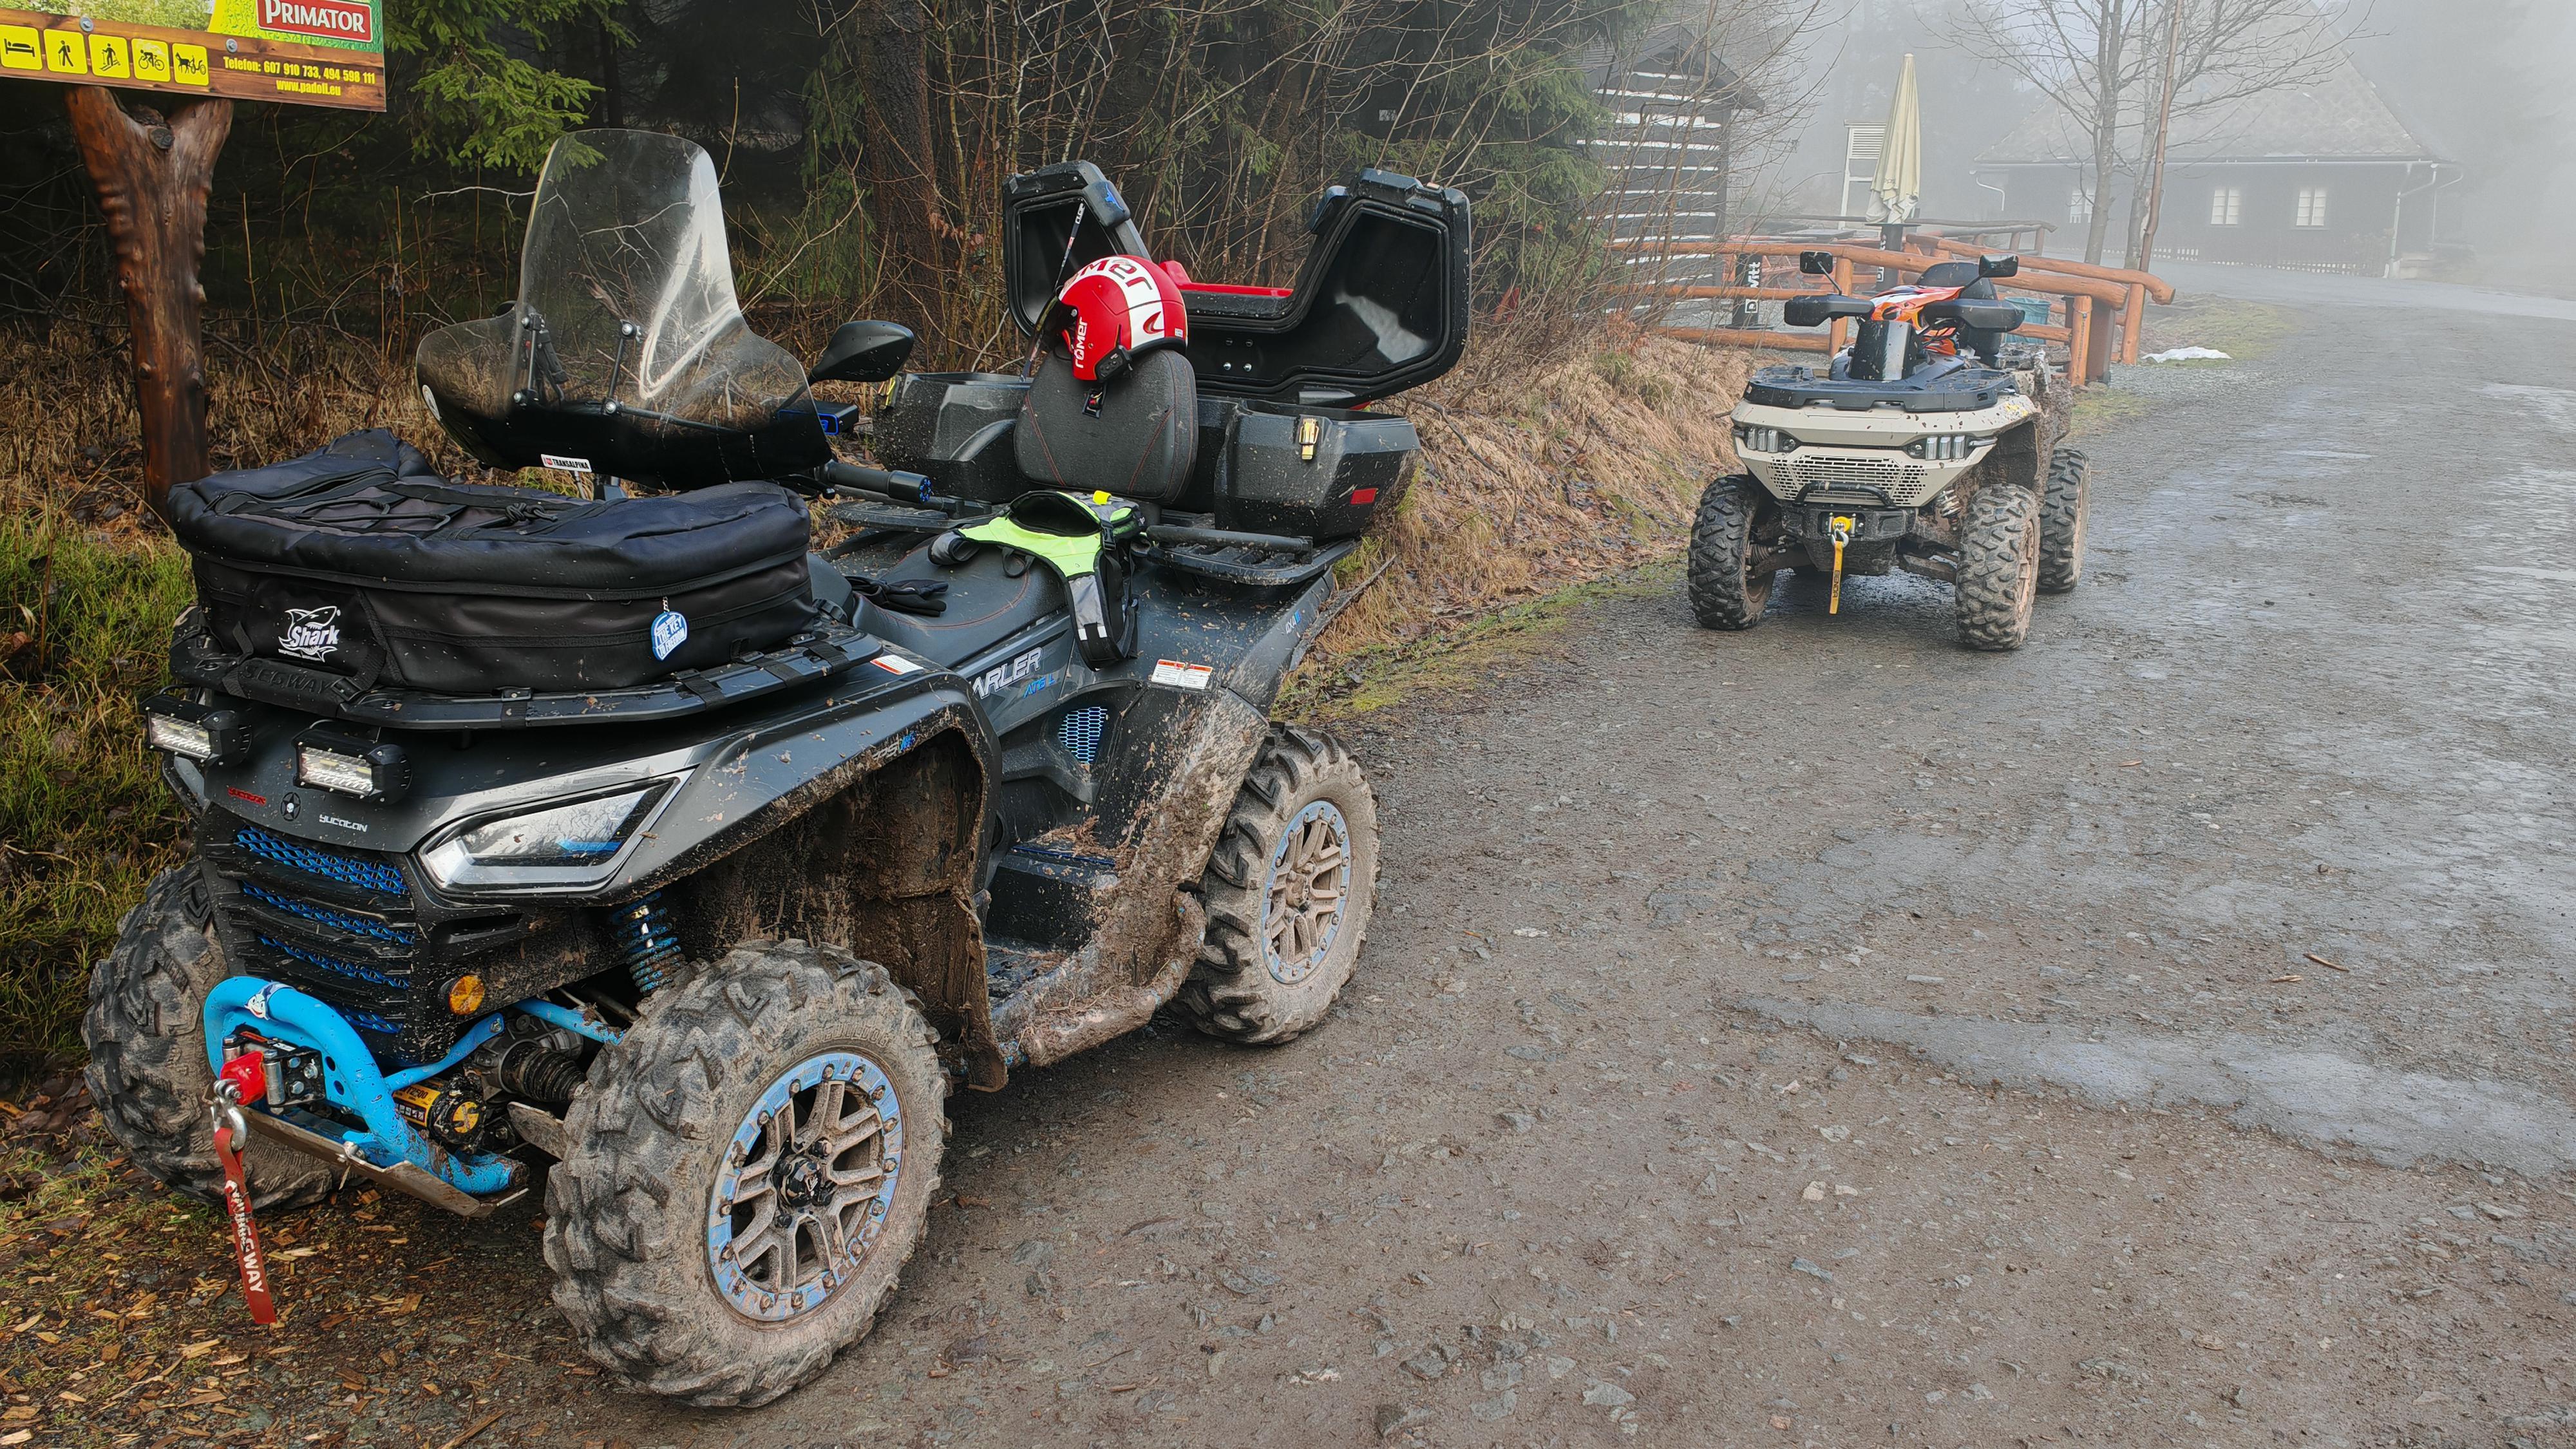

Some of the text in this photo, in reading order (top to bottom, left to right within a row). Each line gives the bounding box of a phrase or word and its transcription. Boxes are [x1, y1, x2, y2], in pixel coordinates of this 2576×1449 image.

[223, 56, 375, 84] Telefon: 607 910 733, 494 598 111
[551, 458, 590, 469] TRANSALPINA
[290, 625, 340, 647] Shark
[241, 665, 333, 694] SEGWAY
[969, 647, 1043, 699] ARLER
